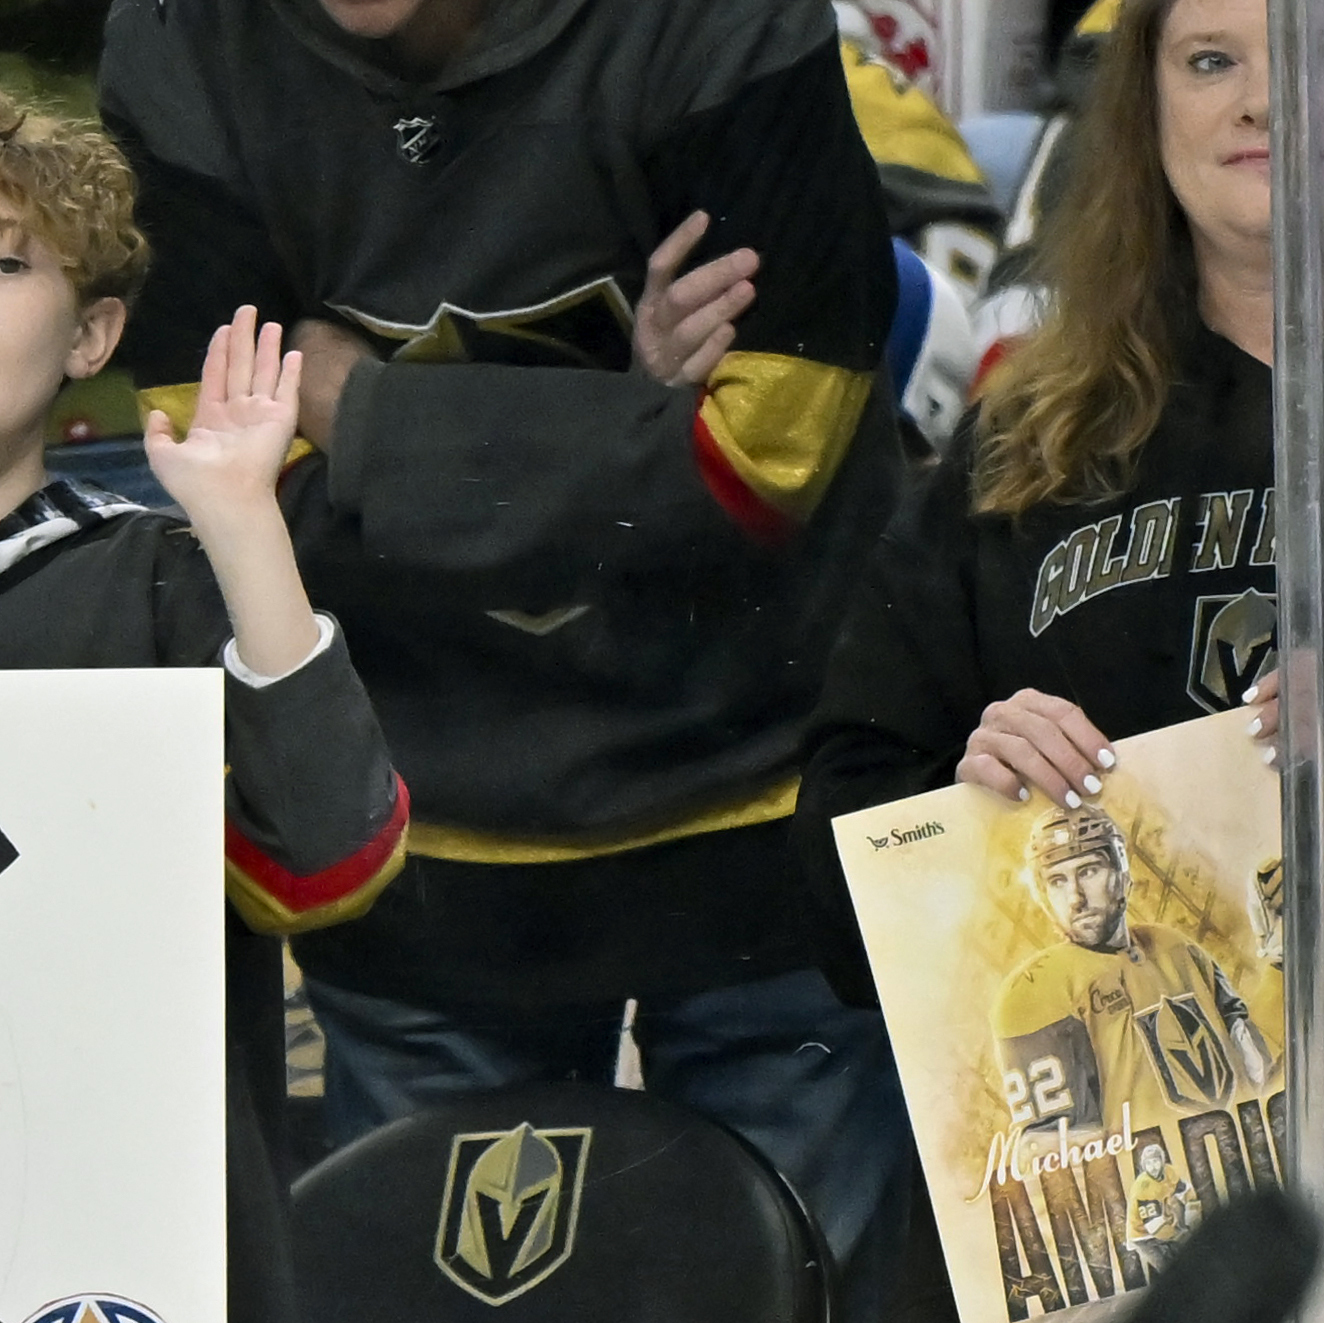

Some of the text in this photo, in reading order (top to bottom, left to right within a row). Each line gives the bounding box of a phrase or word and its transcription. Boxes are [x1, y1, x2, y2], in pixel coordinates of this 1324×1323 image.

[890, 820, 946, 847] Smith's
[1002, 1055, 1074, 1125] 22
[964, 1101, 1139, 1204] Michael
